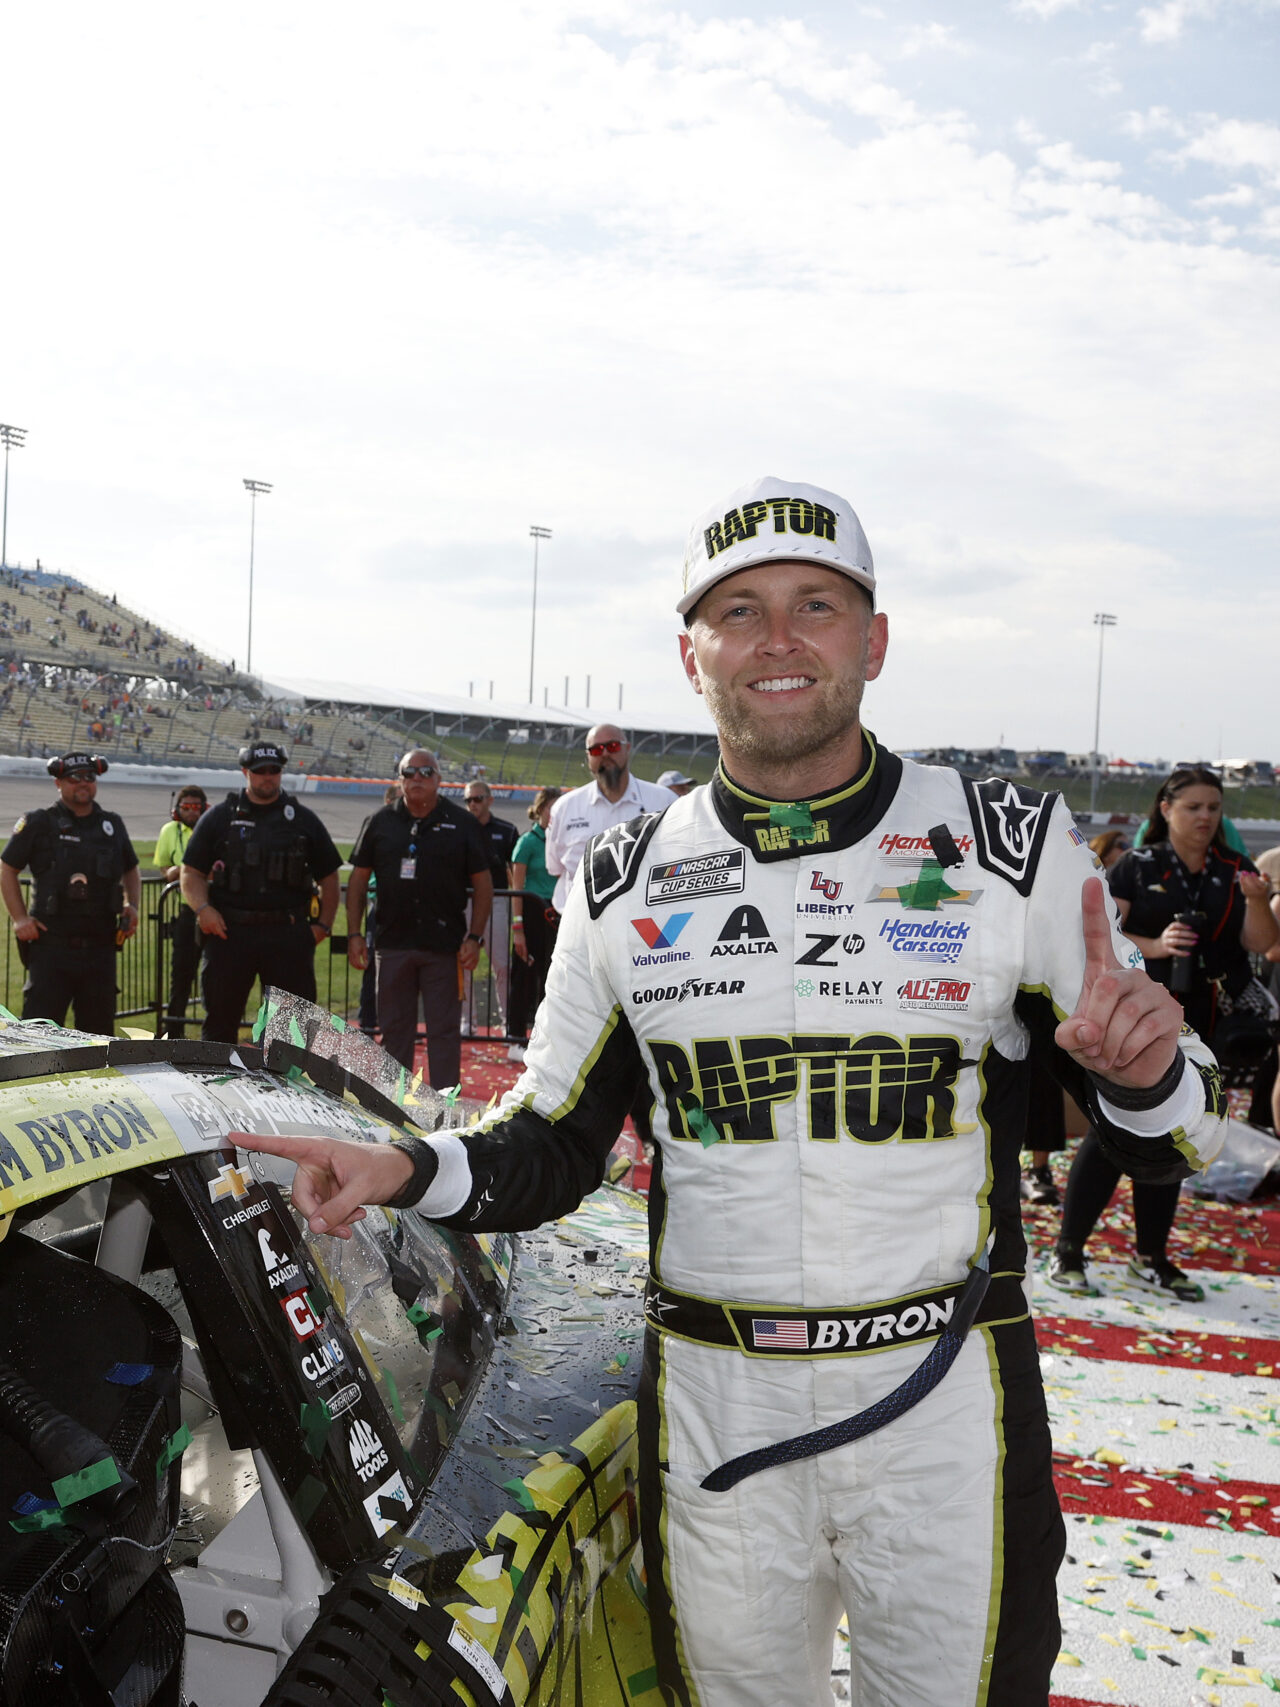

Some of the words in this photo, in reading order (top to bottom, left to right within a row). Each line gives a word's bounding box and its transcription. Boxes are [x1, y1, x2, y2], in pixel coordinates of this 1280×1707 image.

[703, 496, 838, 560] RAPTOR
[755, 819, 830, 852] RAPTOR
[679, 855, 731, 875] NASCAR
[660, 879, 688, 894] CUP
[686, 872, 730, 890] SERIES
[796, 903, 855, 915] LIBERTY
[796, 913, 856, 921] UNIVERSITY
[878, 919, 971, 942] Hendrick
[710, 941, 778, 957] AXALTA
[892, 937, 963, 953] Cars.com
[632, 951, 691, 967] Valvoline
[632, 978, 746, 1005] GOODYEAR
[820, 981, 884, 996] RELAY
[897, 979, 971, 1002] ALL-PRO
[645, 1031, 965, 1144] RAPTOR
[15, 1097, 159, 1173] BYRON
[222, 1199, 271, 1231] CHEVROLET
[268, 1263, 300, 1290] AXALTA
[810, 1296, 956, 1350] BYRON
[301, 1337, 345, 1381] CLIMB
[349, 1418, 383, 1470] MAC
[357, 1449, 390, 1484] TOOLS
[460, 1644, 480, 1663] JUN
